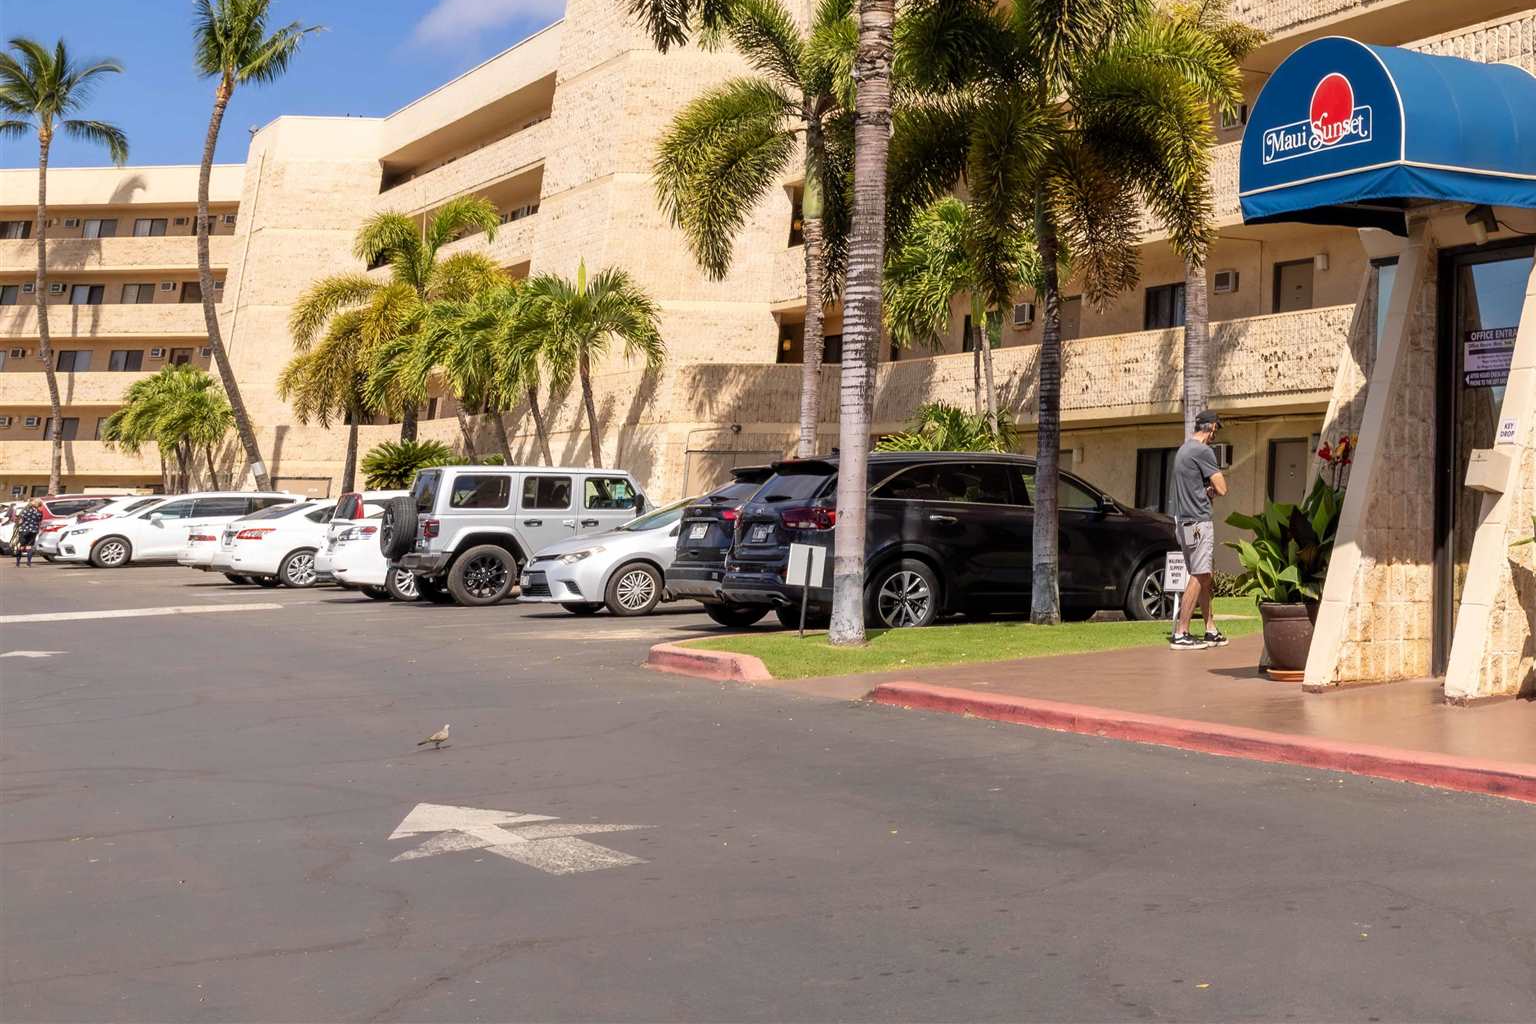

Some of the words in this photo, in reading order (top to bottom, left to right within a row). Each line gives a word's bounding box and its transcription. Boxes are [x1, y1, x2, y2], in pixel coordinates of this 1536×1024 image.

[1266, 126, 1306, 161] Maui
[1309, 112, 1367, 150] Sunset
[1471, 330, 1494, 340] OFFICE
[1496, 328, 1517, 338] ENTRA
